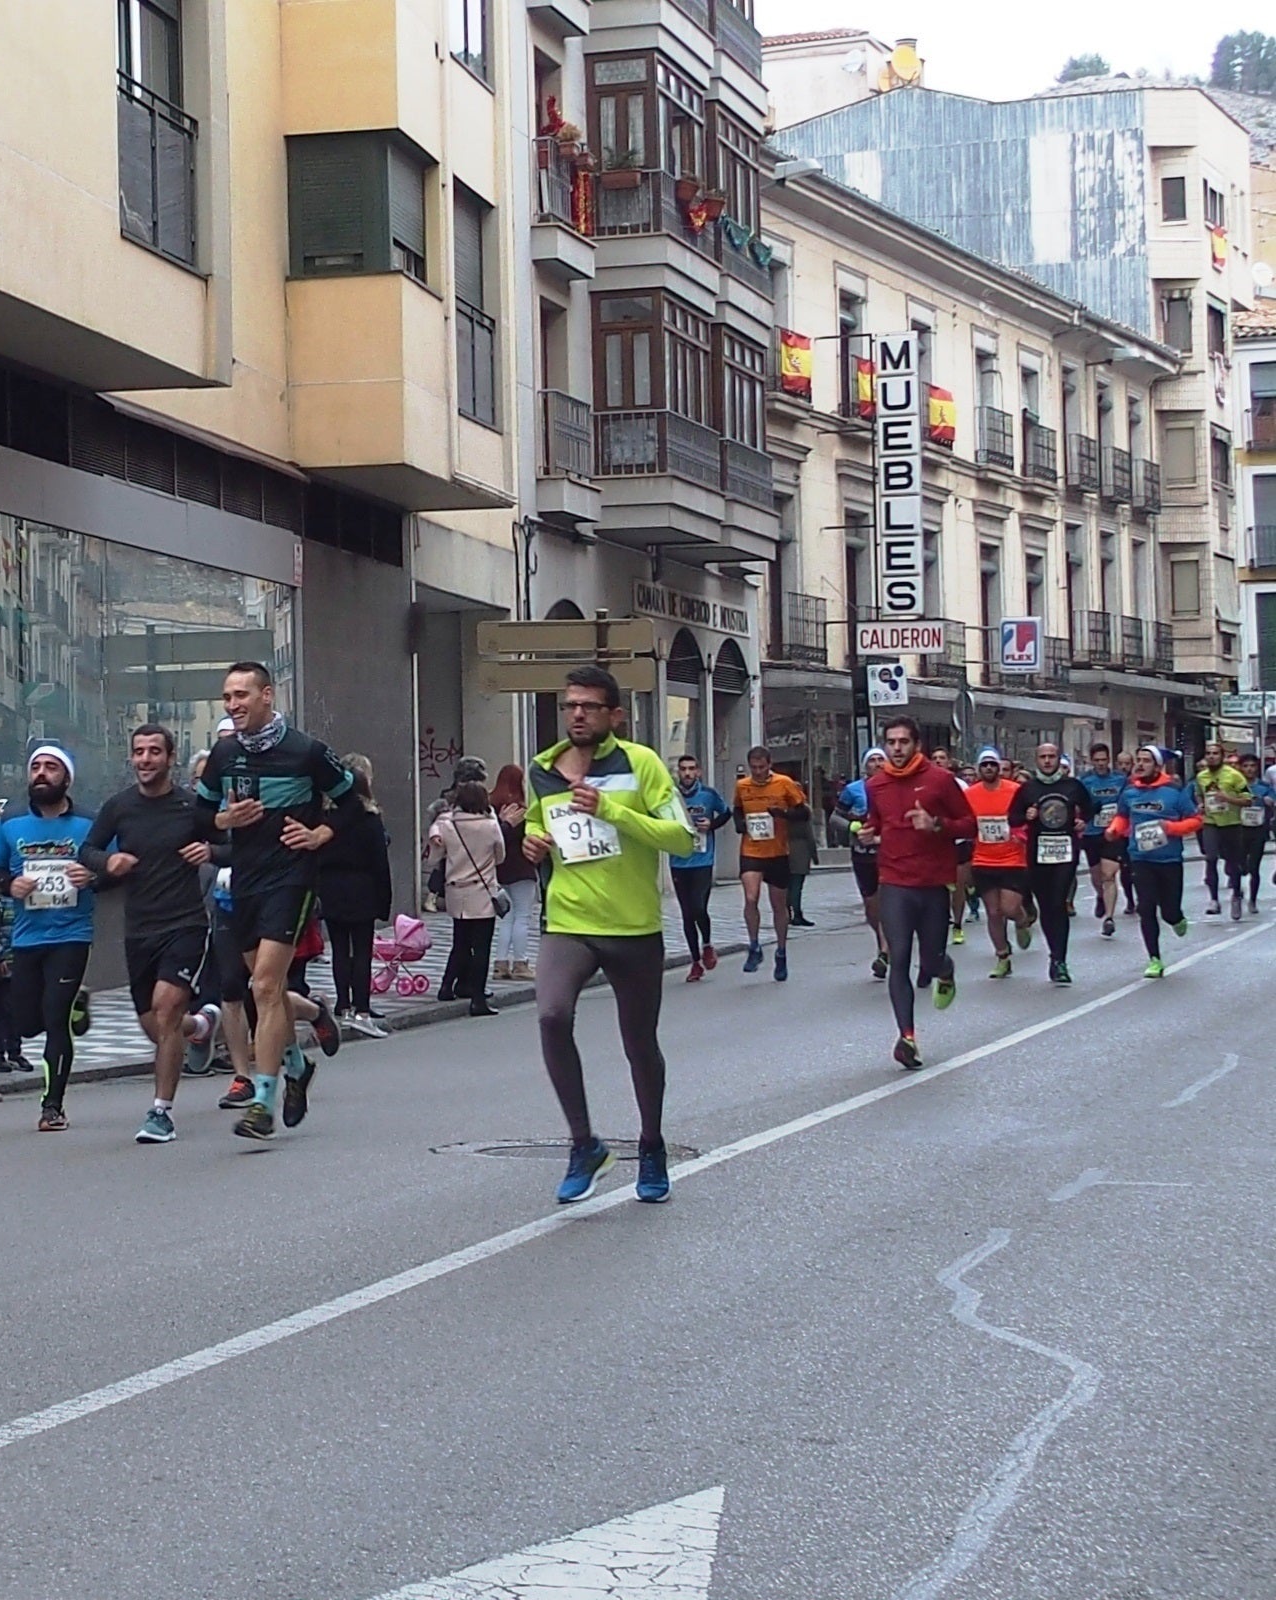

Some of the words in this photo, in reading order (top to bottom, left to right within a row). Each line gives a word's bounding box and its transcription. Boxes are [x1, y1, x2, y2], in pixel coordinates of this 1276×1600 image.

[880, 340, 917, 612] MUEBLES
[860, 627, 942, 649] CALDERON
[569, 819, 593, 840] 91
[588, 840, 612, 856] bk
